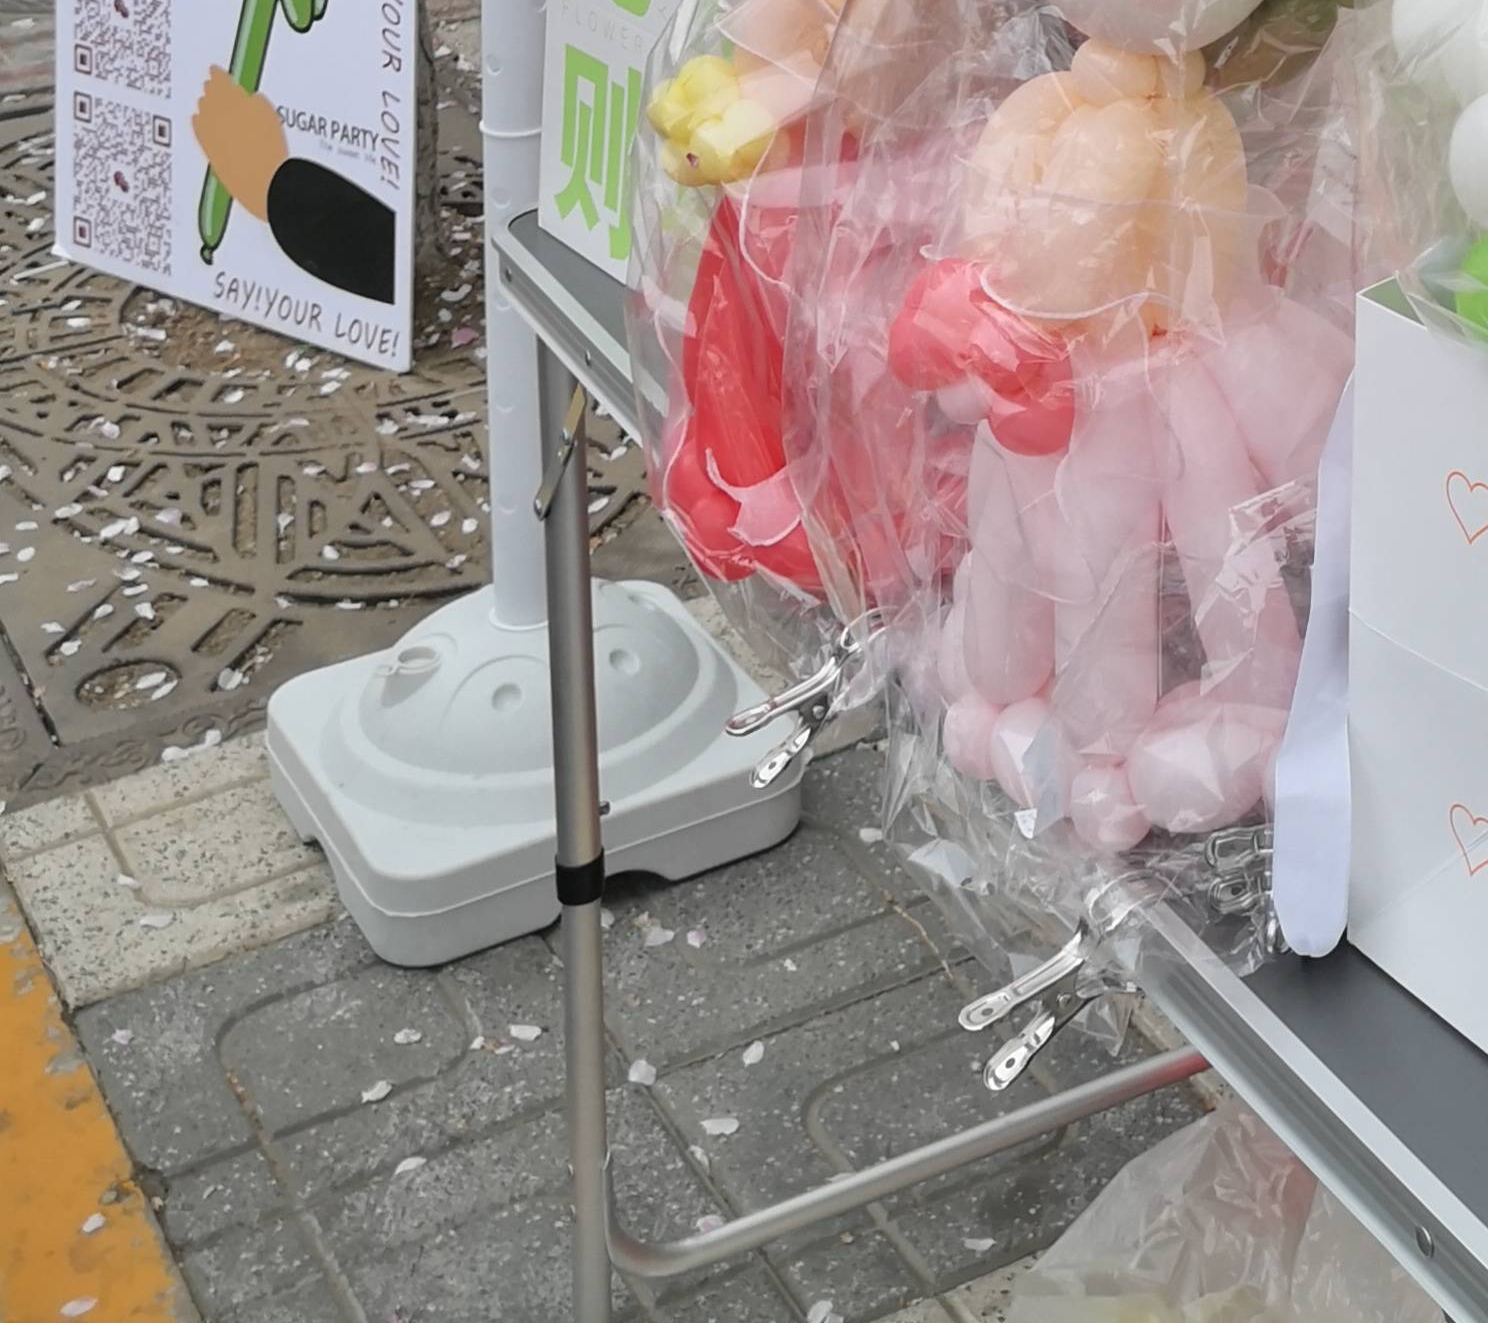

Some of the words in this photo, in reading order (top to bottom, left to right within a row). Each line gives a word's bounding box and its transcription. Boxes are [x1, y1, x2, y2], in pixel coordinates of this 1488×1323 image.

[276, 104, 328, 138] SUGAR
[331, 119, 380, 152] PARTY
[380, 90, 401, 191] LOVE!
[213, 270, 323, 333] SAY!YOUR
[334, 311, 401, 358] LOVE!
